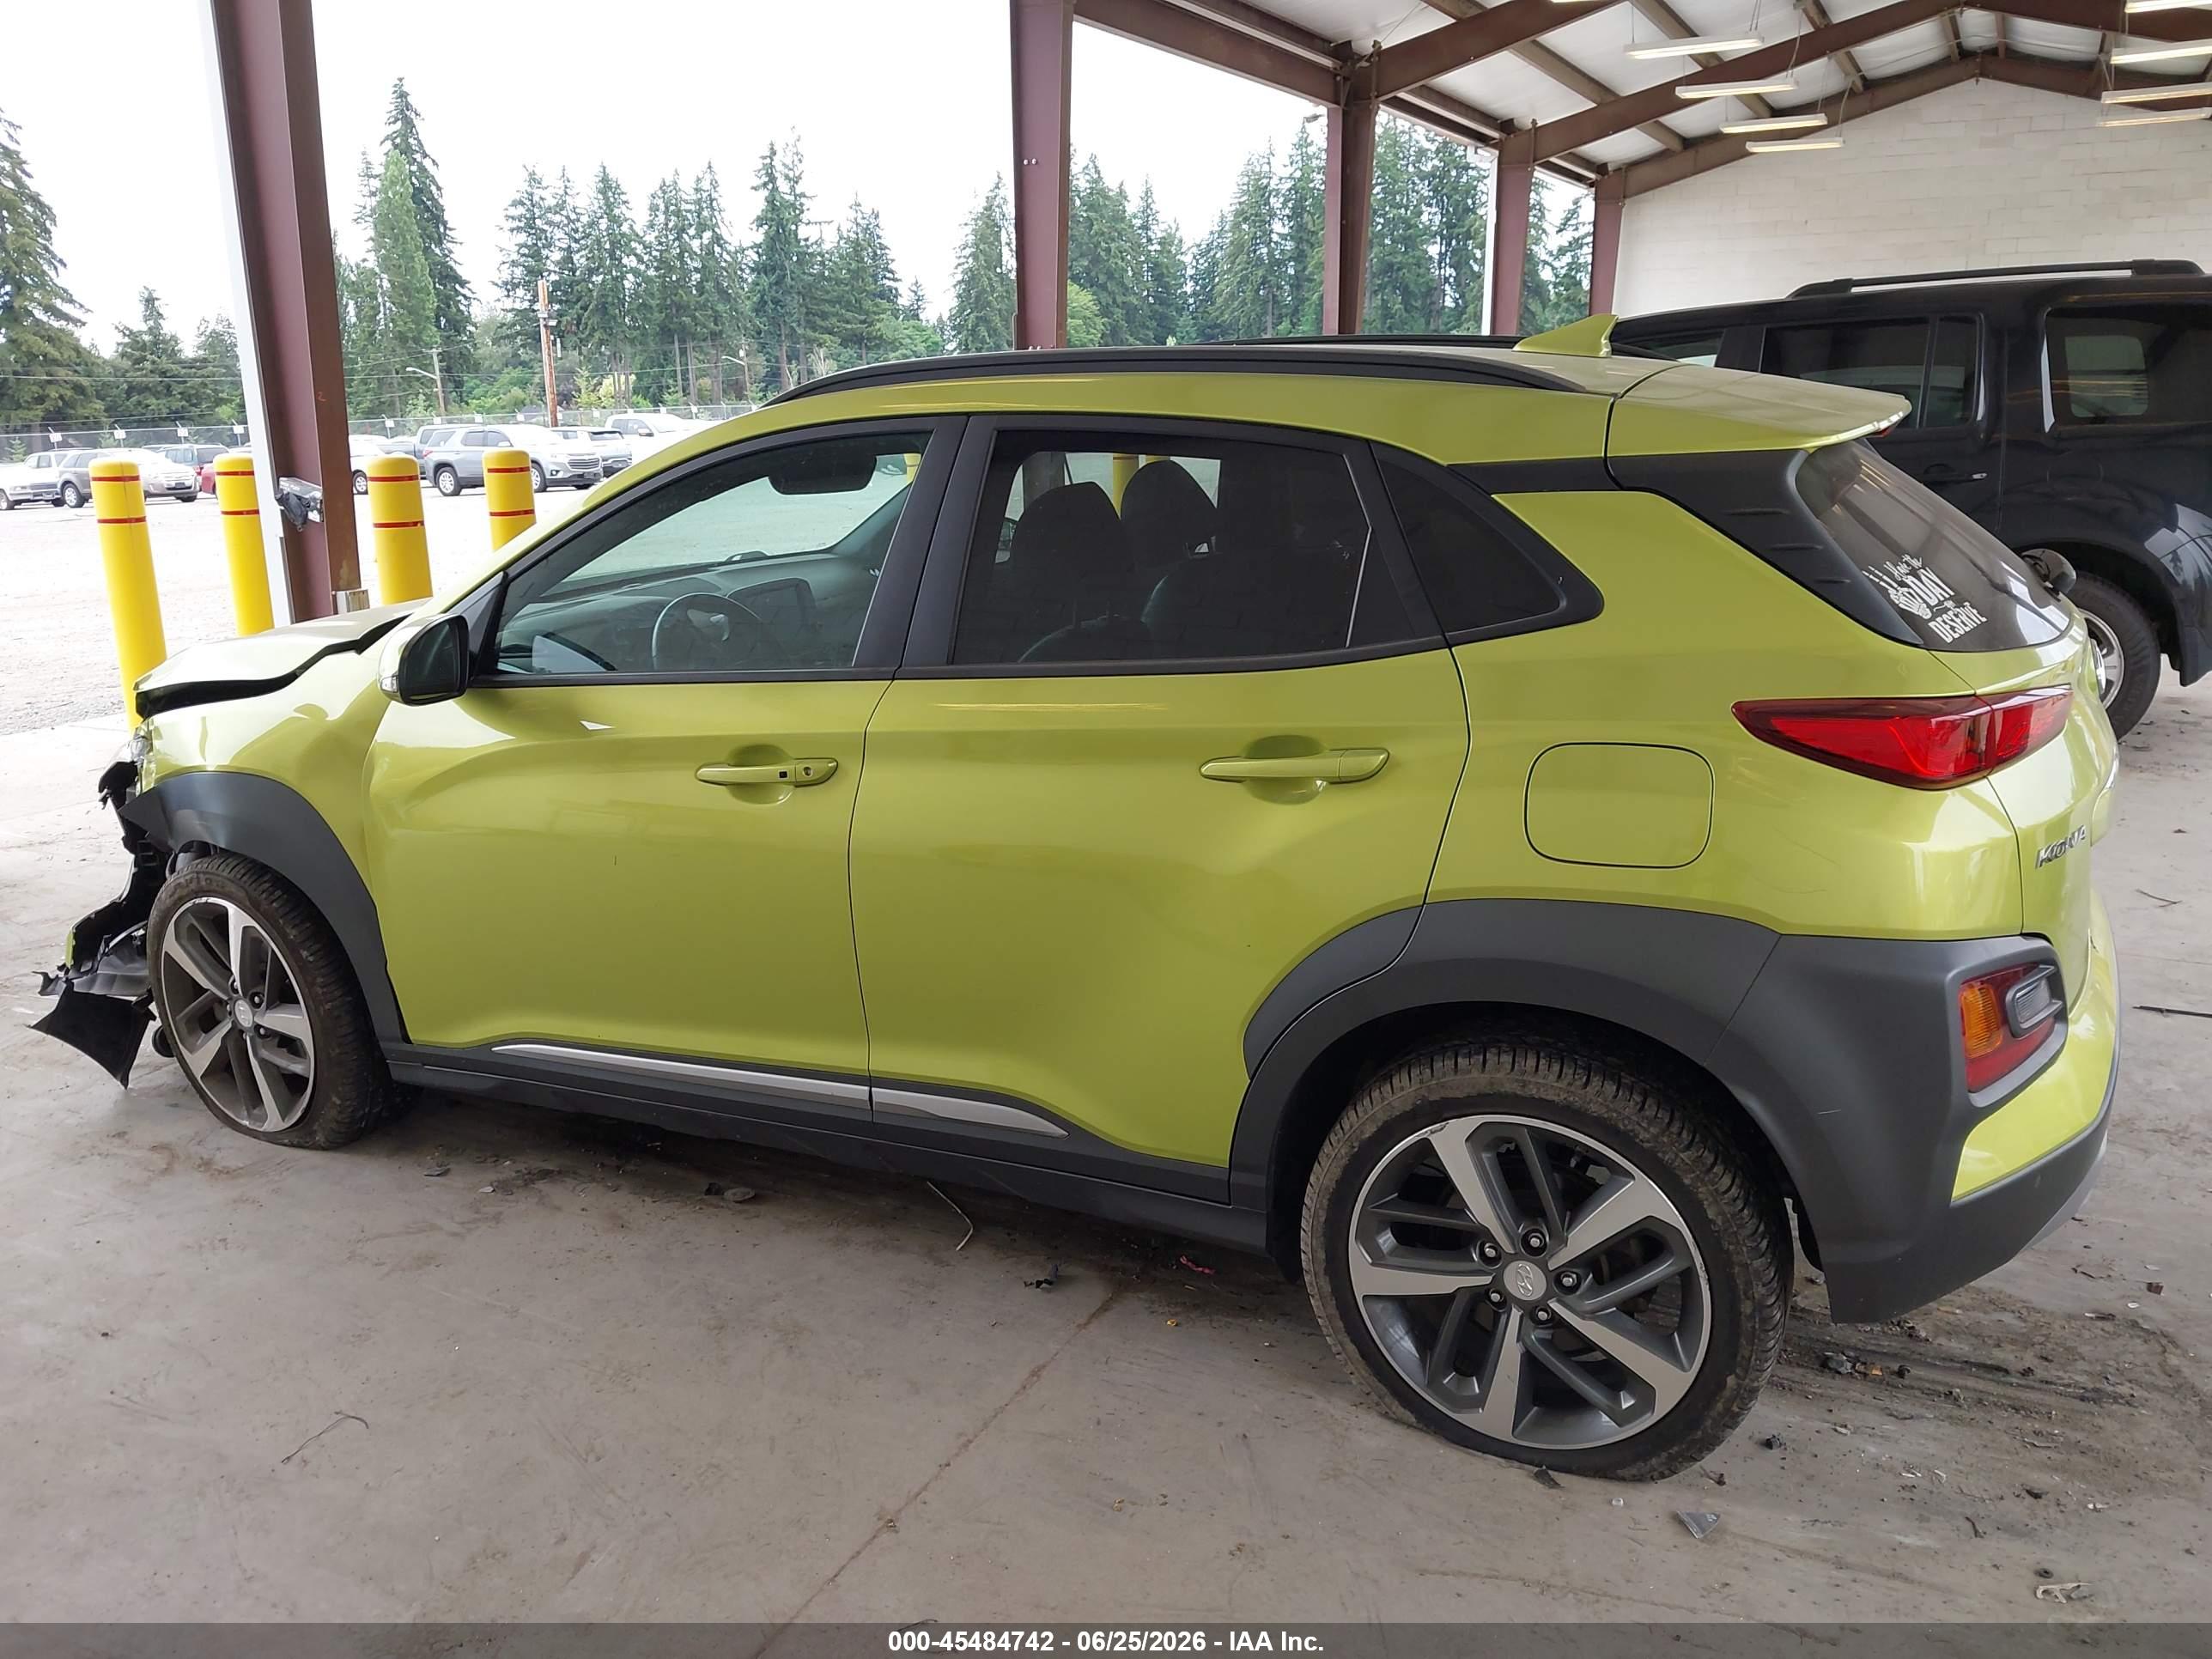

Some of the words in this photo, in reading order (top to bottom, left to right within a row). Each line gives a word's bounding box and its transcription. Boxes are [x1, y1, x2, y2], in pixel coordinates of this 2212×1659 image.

[1902, 567, 1955, 606] DAY
[1928, 602, 1988, 643] DESERVE
[2035, 824, 2086, 869] KONA
